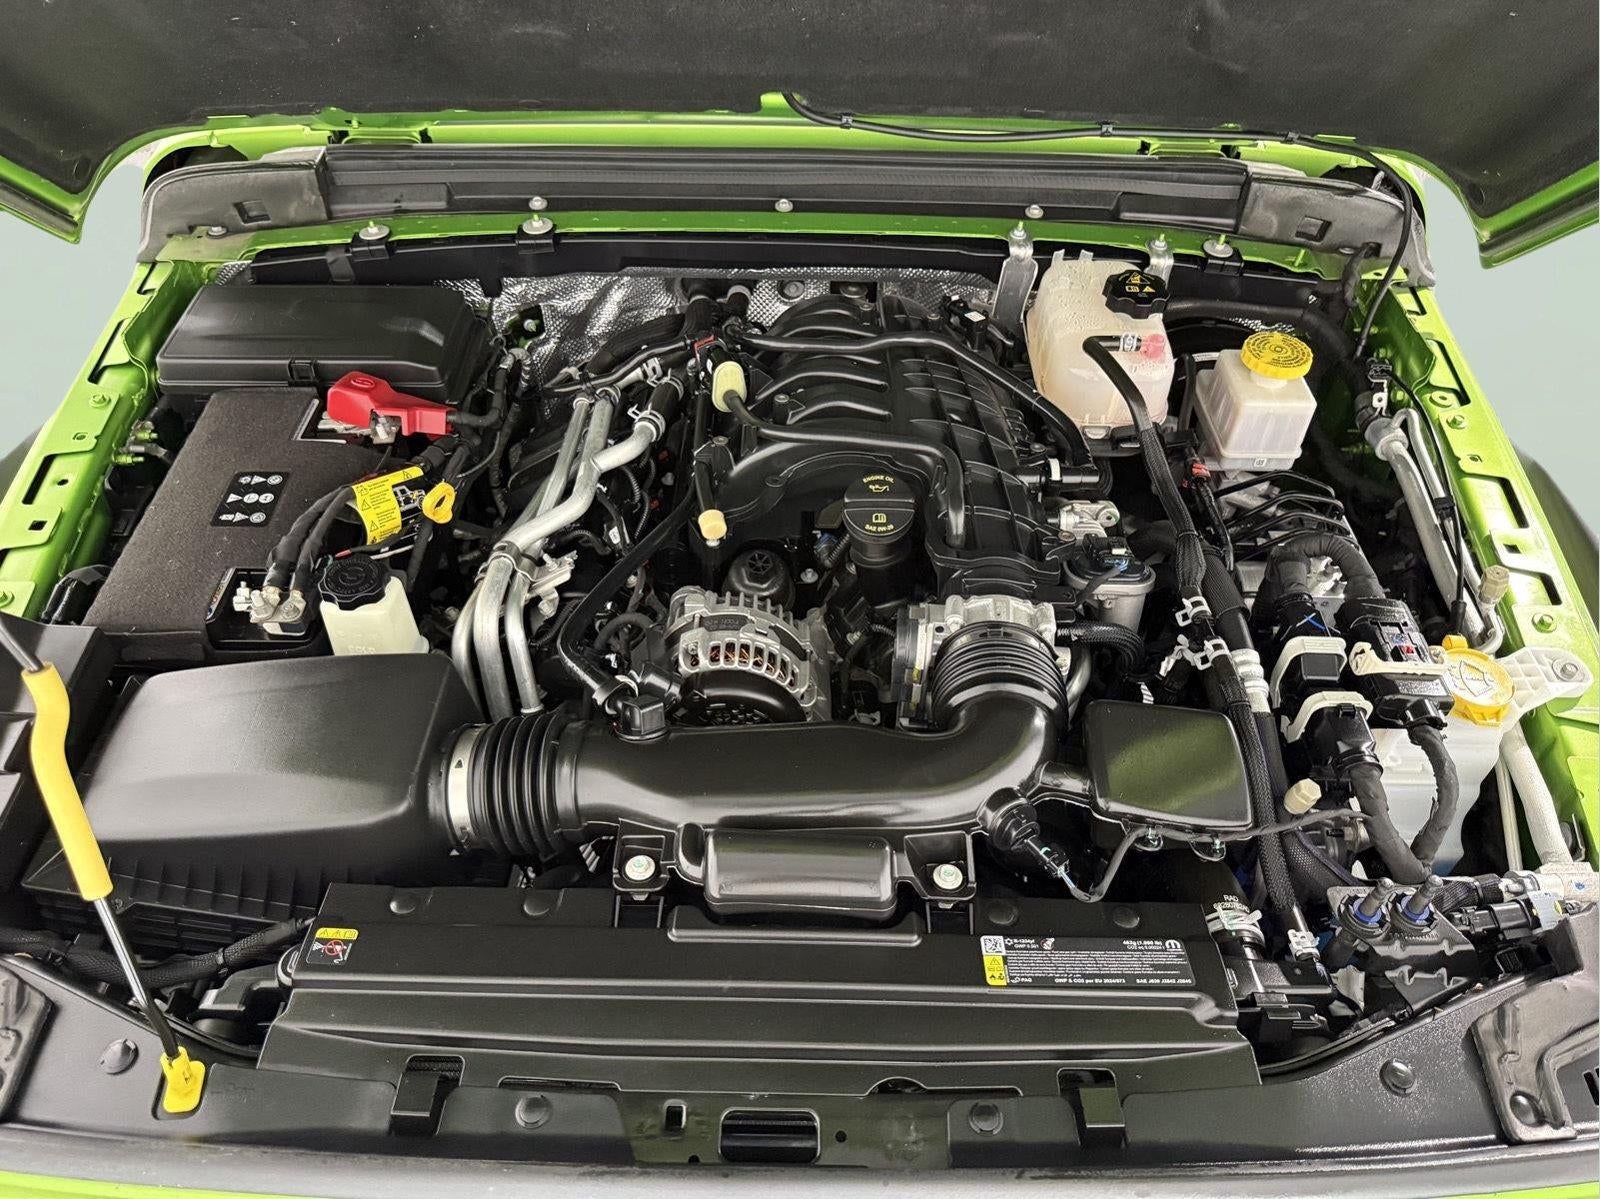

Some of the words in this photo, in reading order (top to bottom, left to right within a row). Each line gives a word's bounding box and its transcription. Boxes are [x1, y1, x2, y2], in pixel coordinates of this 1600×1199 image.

[862, 475, 885, 483] ENGINE
[885, 475, 895, 484] OIL
[864, 524, 877, 532] SAE
[1223, 894, 1239, 902] RAD
